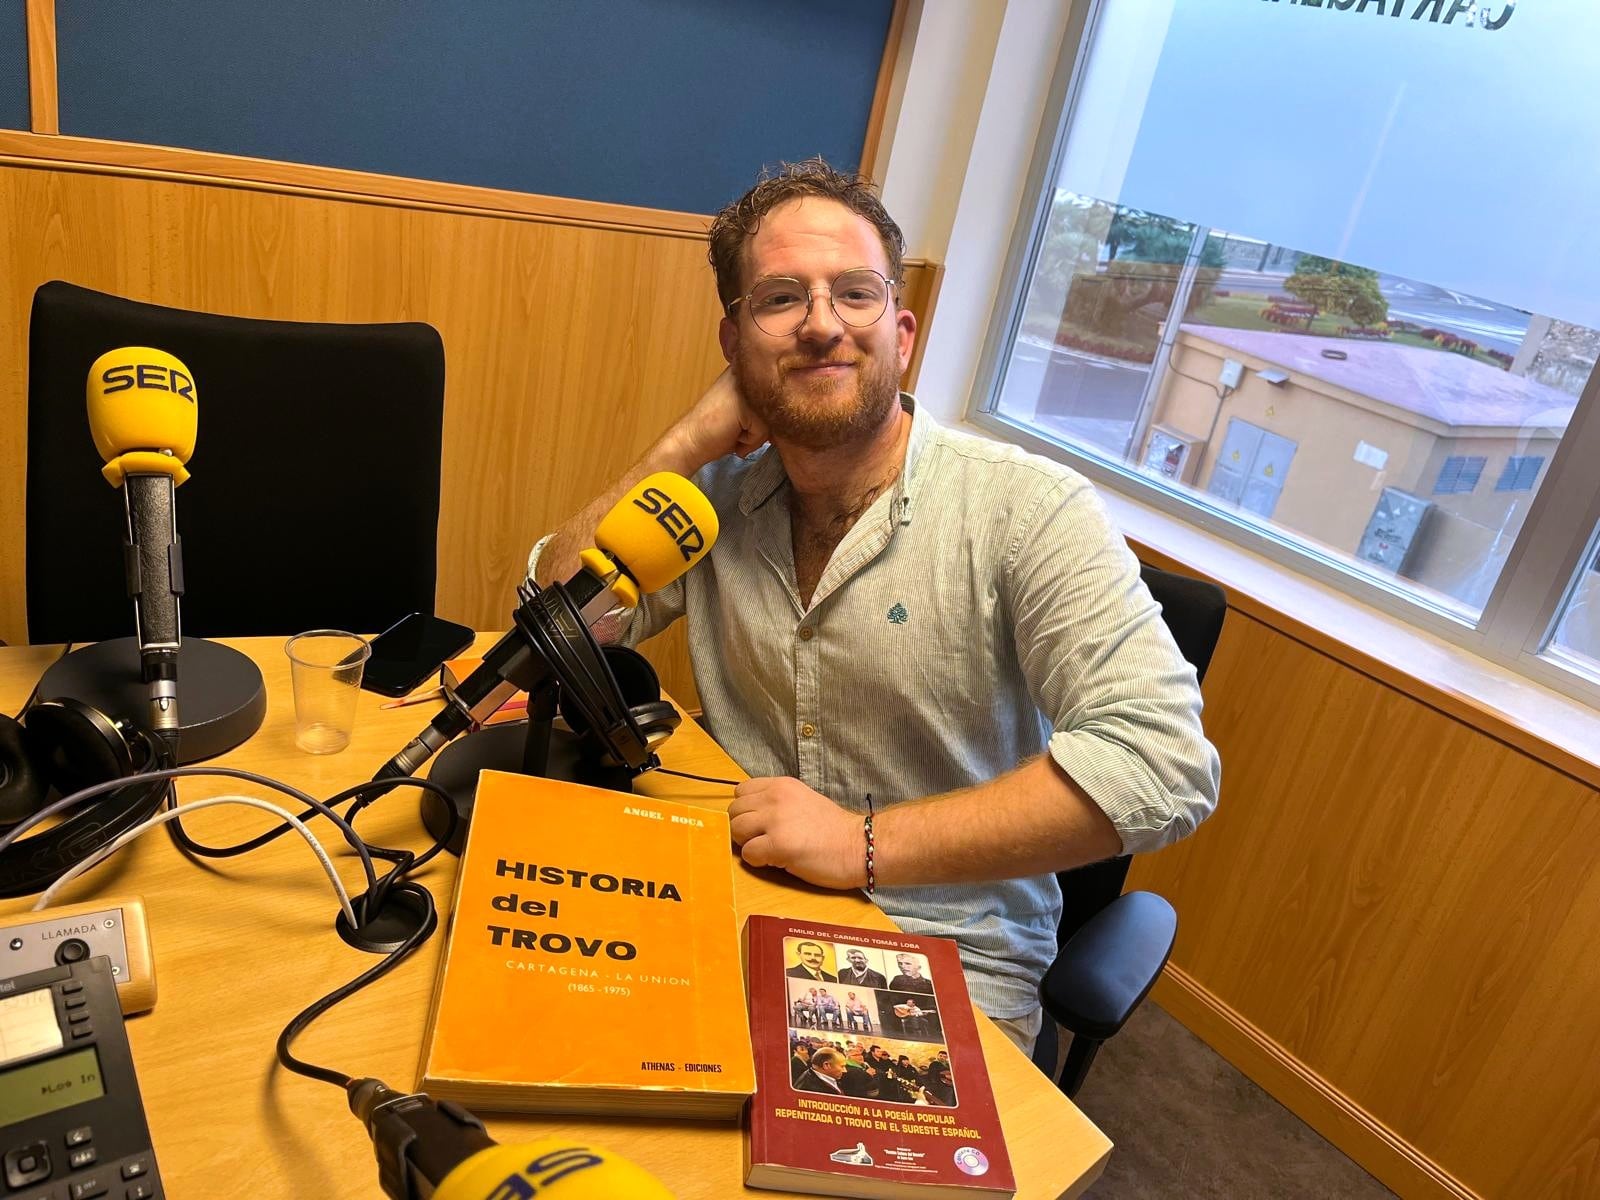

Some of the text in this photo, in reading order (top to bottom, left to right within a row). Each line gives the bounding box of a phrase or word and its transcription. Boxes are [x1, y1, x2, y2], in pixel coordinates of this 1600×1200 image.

[102, 364, 195, 404] SER
[633, 487, 705, 562] SER
[623, 806, 704, 828] ANGEL ROCA
[495, 858, 682, 902] HISTORIA
[491, 893, 559, 918] del
[41, 924, 97, 940] LLAMADA
[487, 925, 637, 961] TROVO
[788, 927, 815, 936] EMILIO
[816, 930, 831, 938] DEL
[833, 932, 870, 943] CARMELO
[900, 942, 920, 950] LOBA
[505, 960, 599, 978] CARTAGENA
[616, 972, 633, 981] LA
[639, 974, 691, 987] UNION
[641, 1062, 675, 1072] ATHENAS
[684, 1063, 722, 1073] EDICIONES
[775, 1108, 982, 1139] REPENTIZADA O TROVO EN EL SURESTE ESPAÑOL
[798, 1098, 956, 1125] INTRODUCCIÓN A LA POESÍA POPULAR
